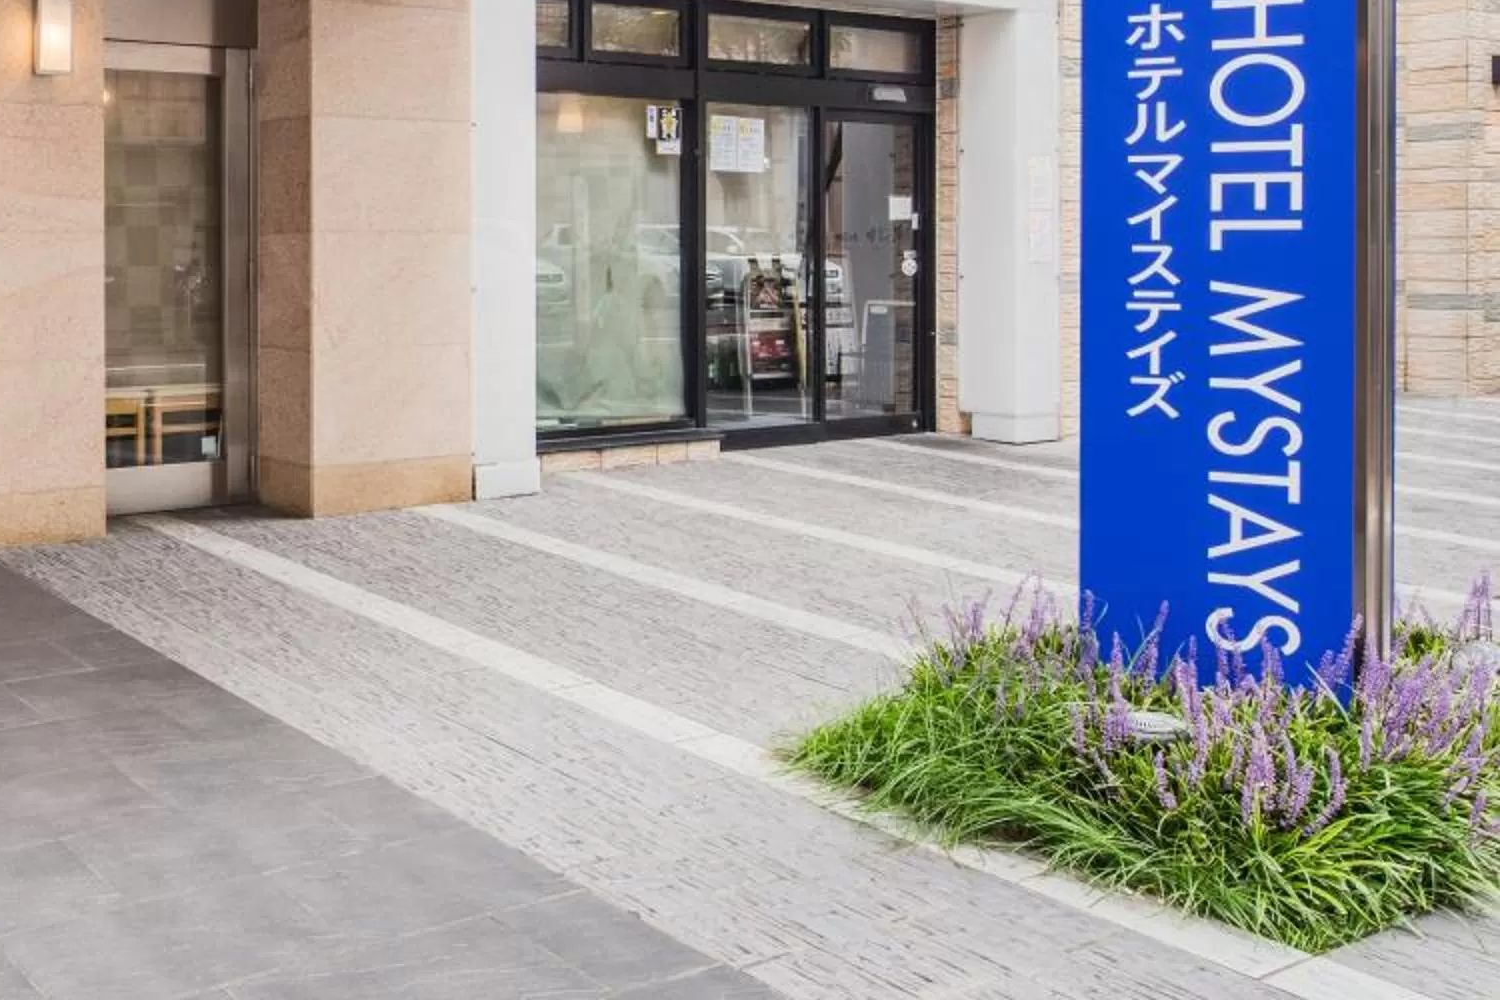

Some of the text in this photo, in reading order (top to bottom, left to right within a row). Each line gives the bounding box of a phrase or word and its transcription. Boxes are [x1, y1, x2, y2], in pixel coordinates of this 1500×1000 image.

[1125, 3, 1187, 420] ホテルマイステイズ
[1205, 280, 1304, 656] MYSTAYS
